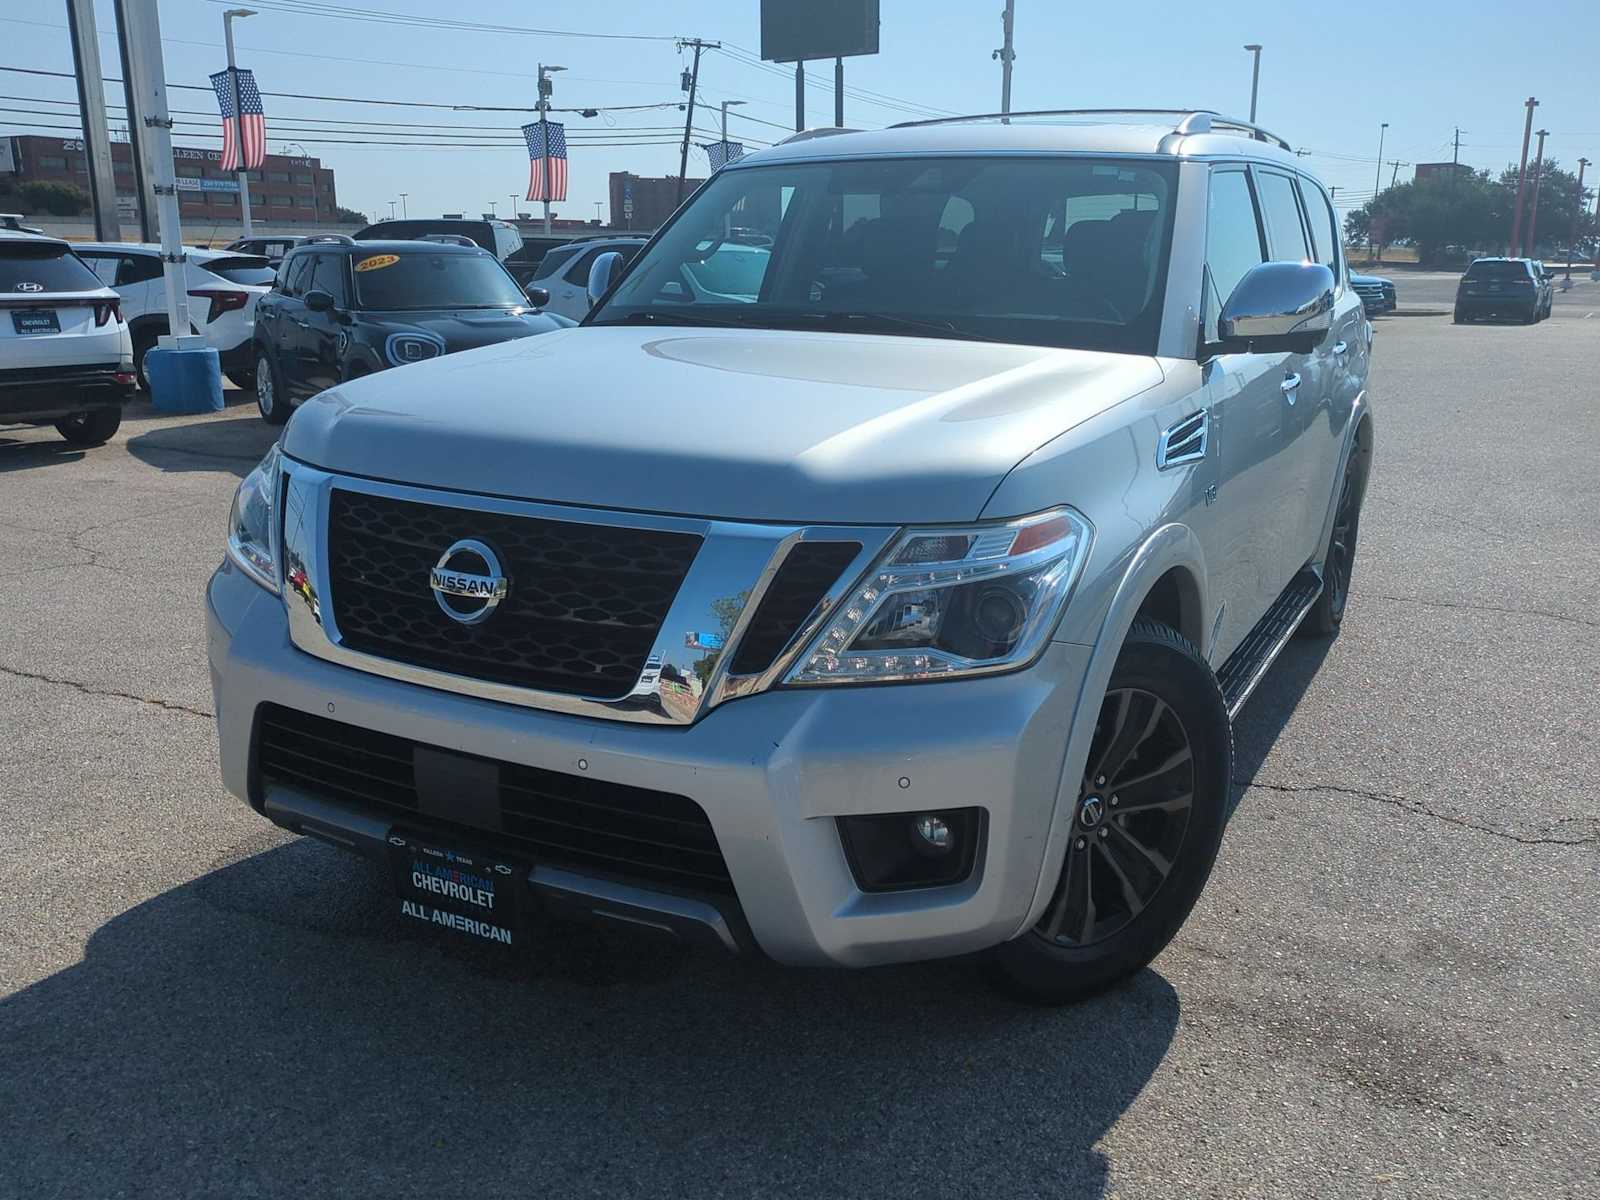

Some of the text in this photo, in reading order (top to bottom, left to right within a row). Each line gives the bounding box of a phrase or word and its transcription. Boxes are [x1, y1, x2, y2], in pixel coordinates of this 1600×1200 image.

[360, 255, 395, 270] 2023
[431, 571, 497, 597] NISSAN
[412, 871, 495, 909] CHEVROLET
[402, 900, 512, 945] ALL AMERICAN
